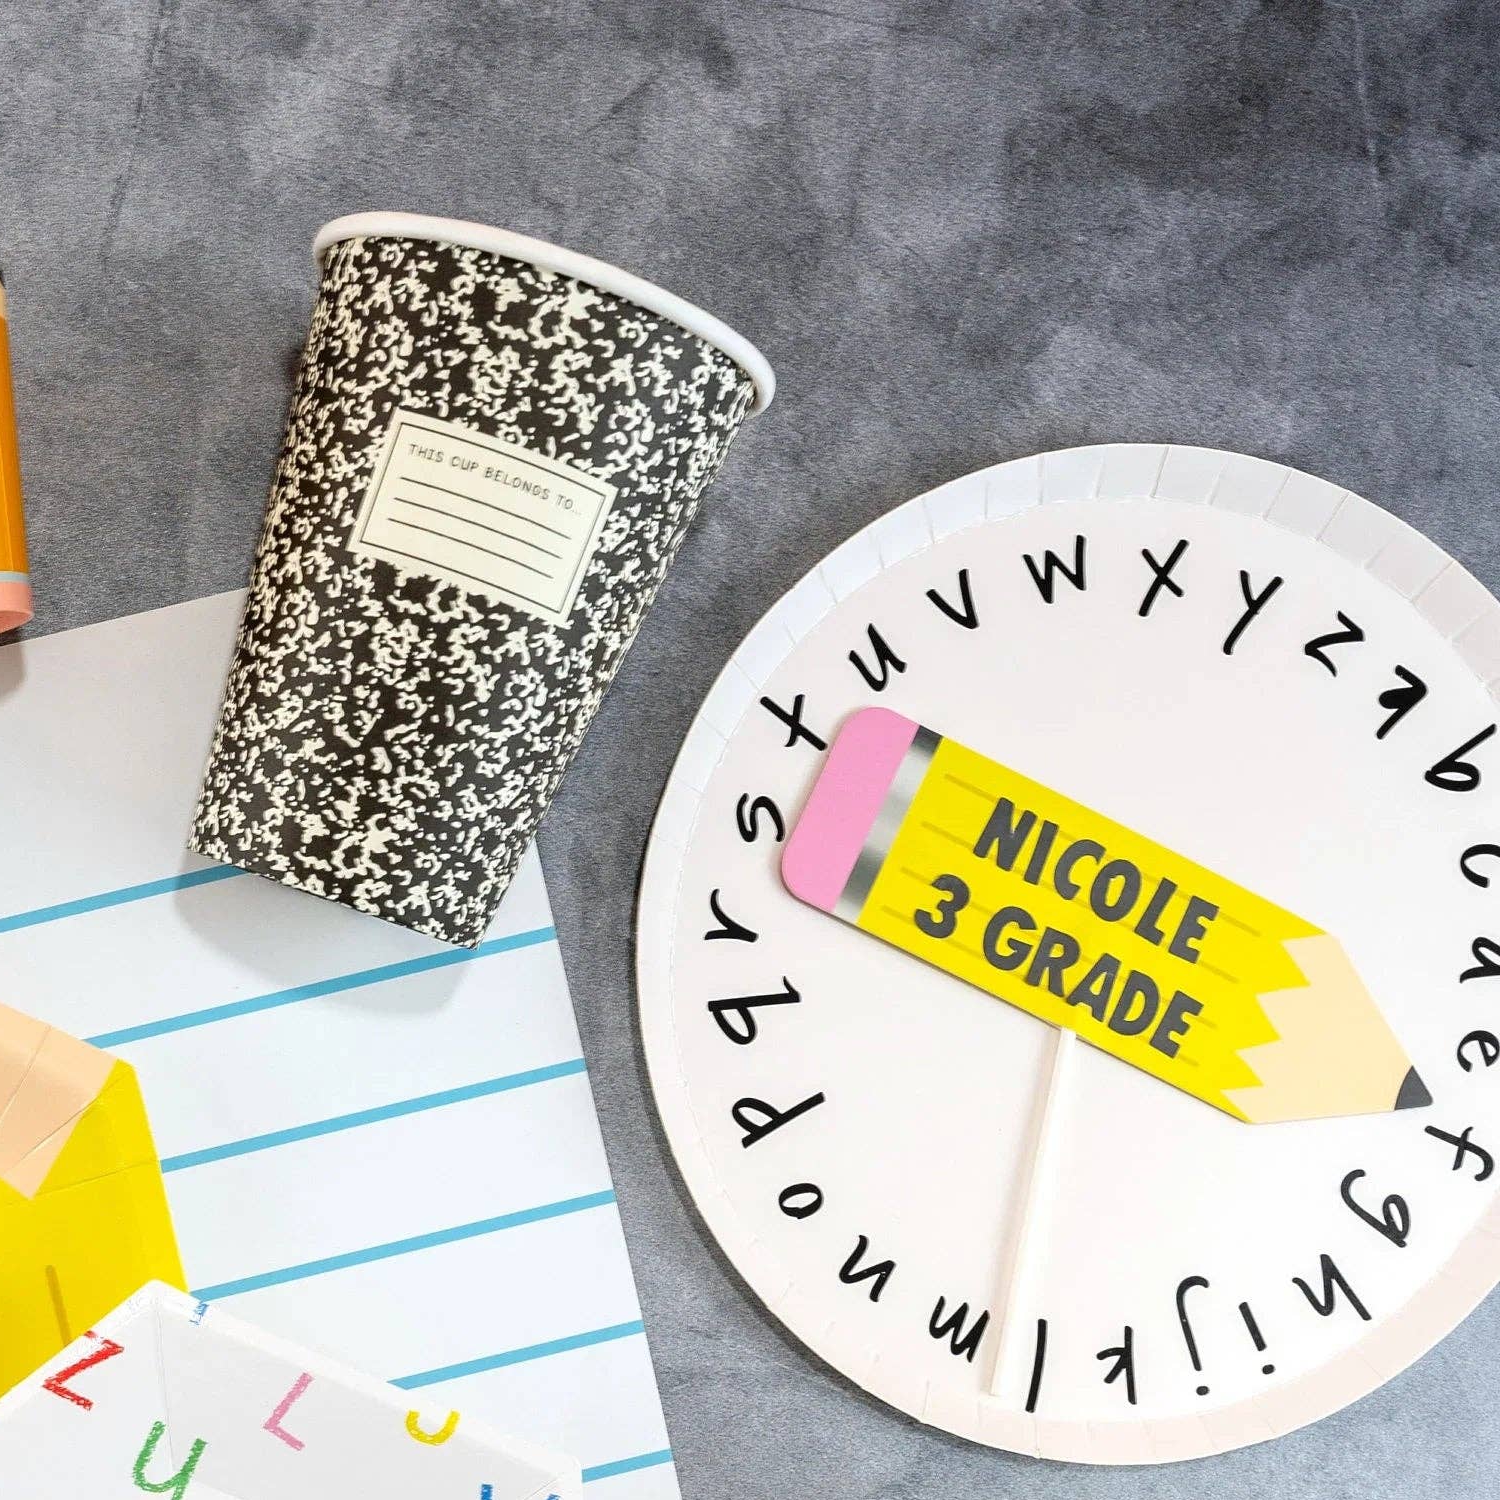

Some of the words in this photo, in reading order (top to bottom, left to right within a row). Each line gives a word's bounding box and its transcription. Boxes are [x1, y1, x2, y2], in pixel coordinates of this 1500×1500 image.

[408, 443, 445, 463] THIS
[450, 455, 479, 472] CUP
[484, 466, 550, 500] BELONGS
[973, 797, 1220, 964] NICOLE
[914, 873, 970, 939] 3
[982, 906, 1204, 1059] GRADE
[263, 1372, 313, 1451] L
